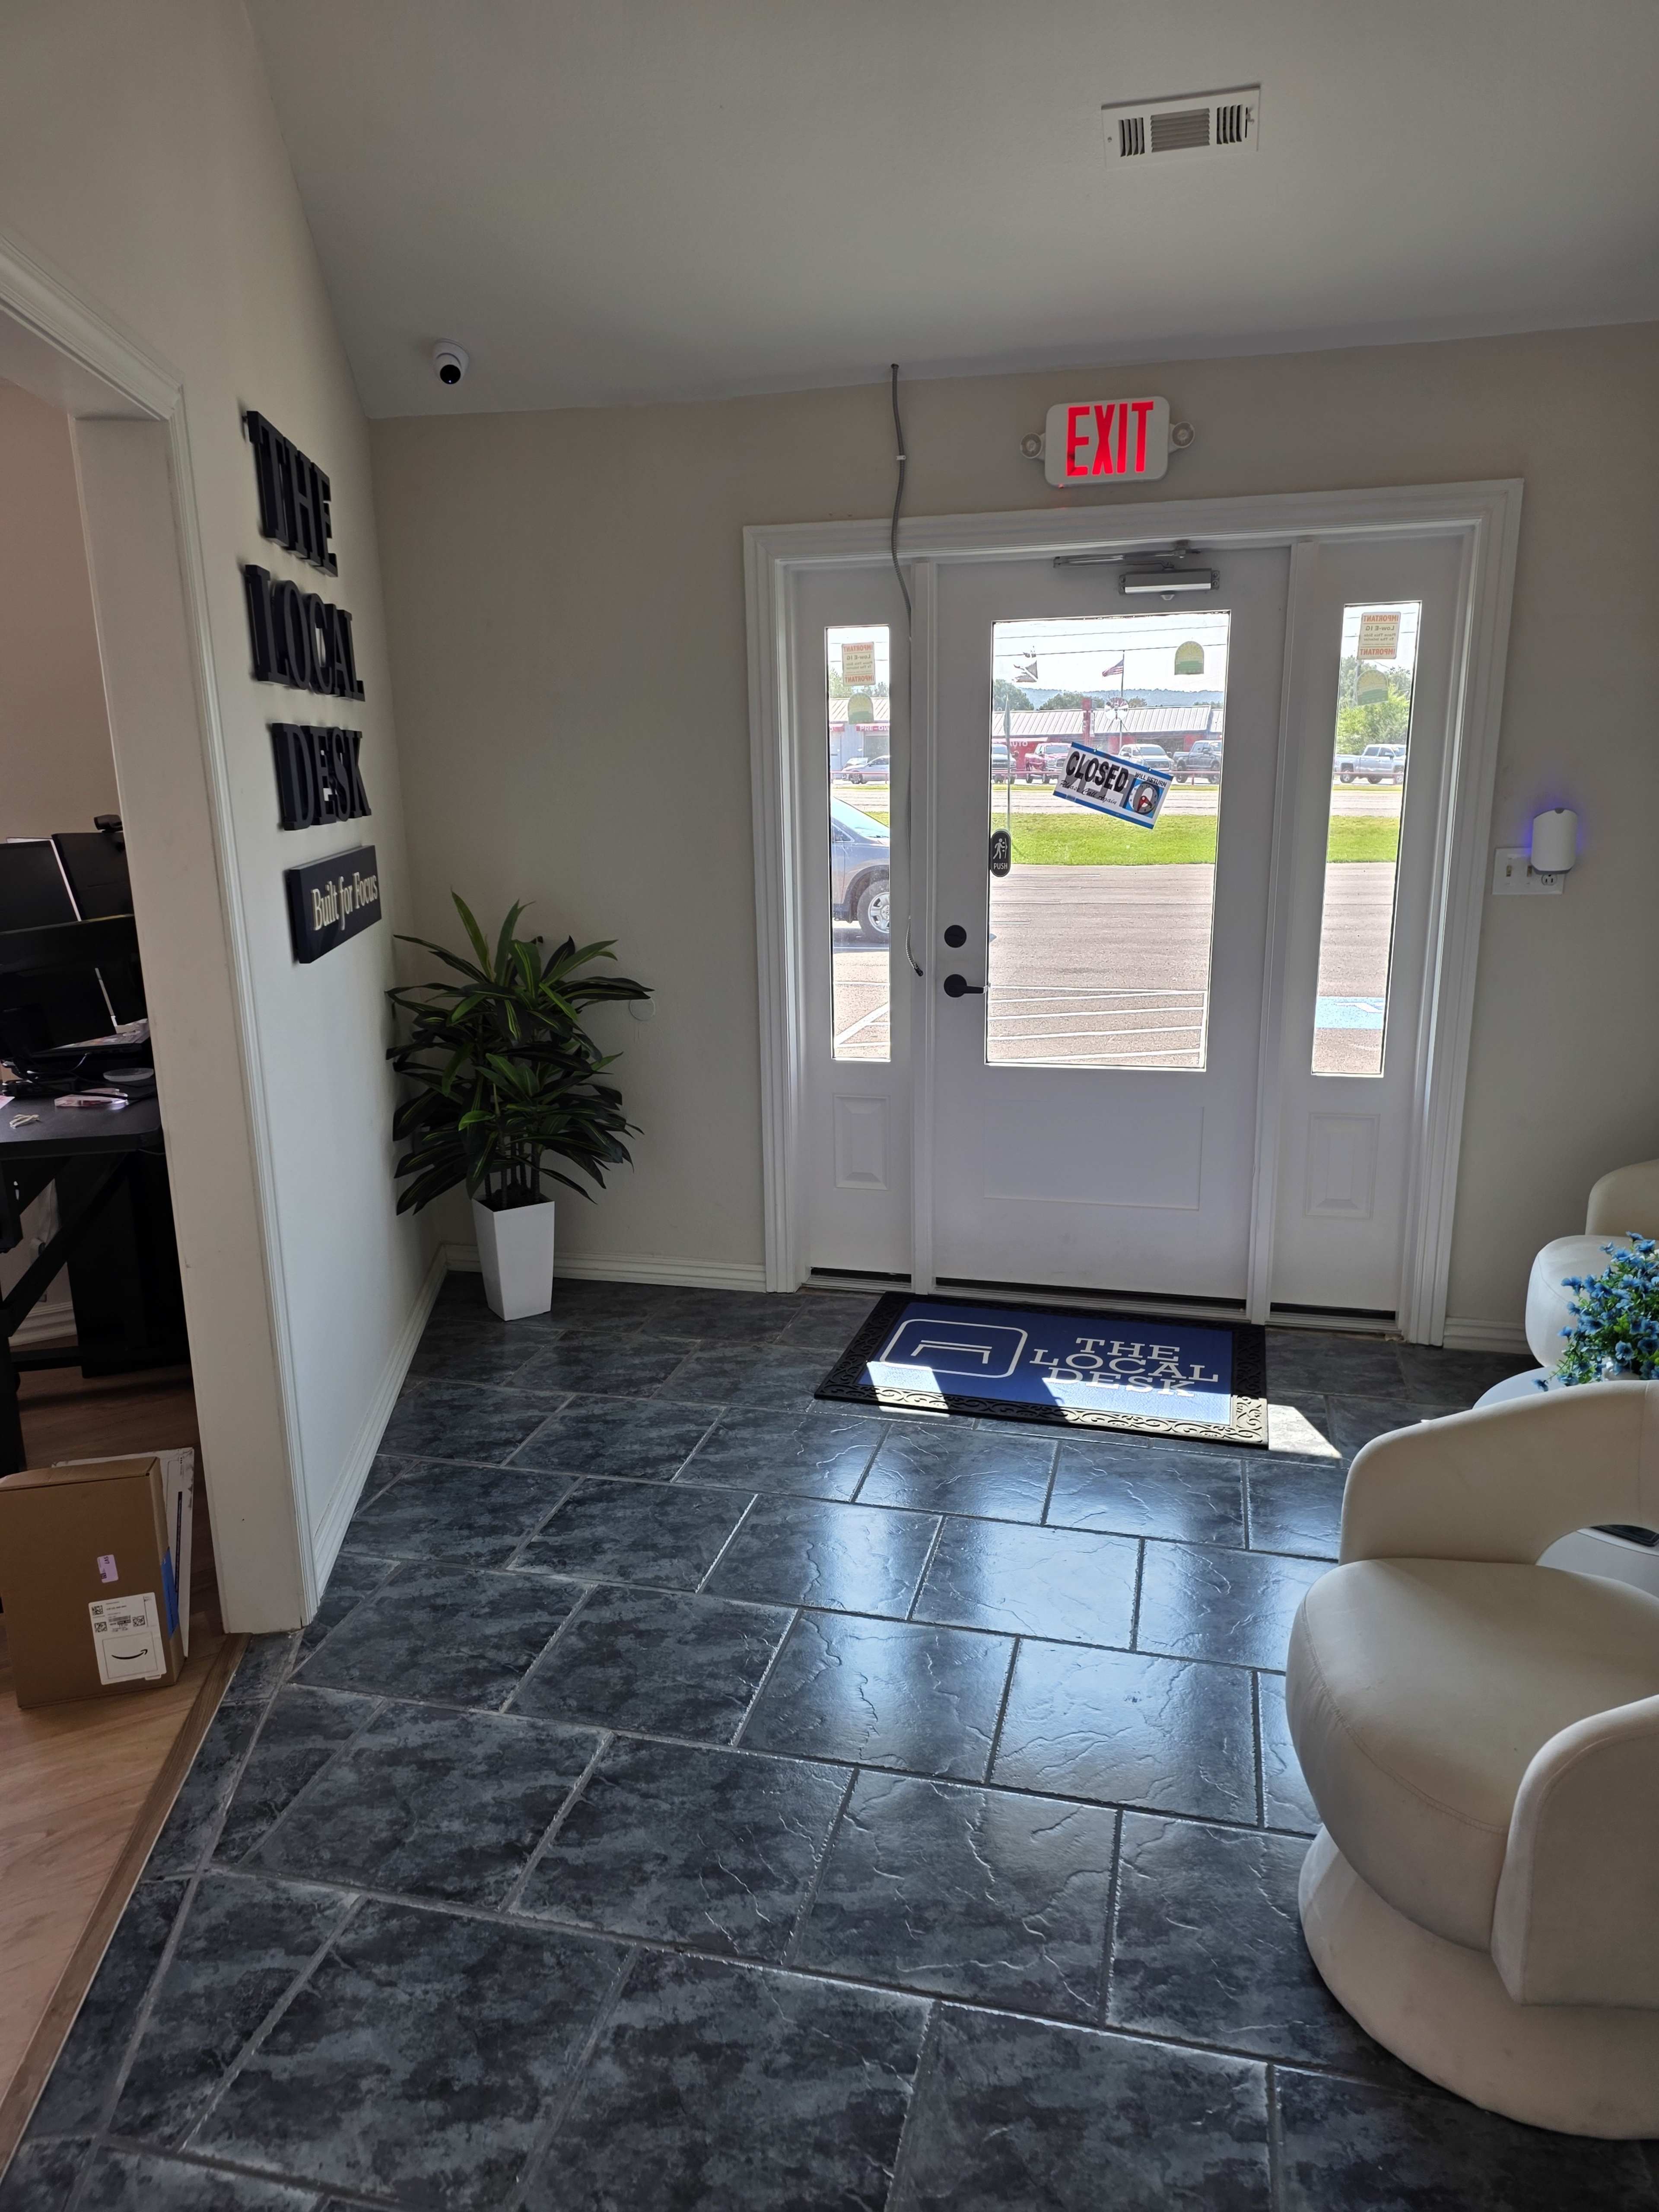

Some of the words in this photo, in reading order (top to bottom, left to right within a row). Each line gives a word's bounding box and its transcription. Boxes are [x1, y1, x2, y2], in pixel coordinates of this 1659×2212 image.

[1067, 400, 1154, 476] EXIT
[247, 411, 338, 577] THE
[245, 564, 364, 701] LOCAL
[272, 723, 371, 831] DESK
[1066, 751, 1129, 792] CLOSED
[1135, 772, 1147, 781] WILL
[1146, 776, 1167, 787] RETURN
[1059, 780, 1080, 793] Please
[1082, 788, 1096, 798] Call
[1096, 795, 1117, 805] Again
[311, 880, 338, 930] Built
[337, 876, 353, 931] for
[353, 871, 378, 909] Focus
[1030, 1348, 1218, 1382] LOCAL
[1076, 1338, 1180, 1362] THE
[1045, 1367, 1195, 1397] DESK
